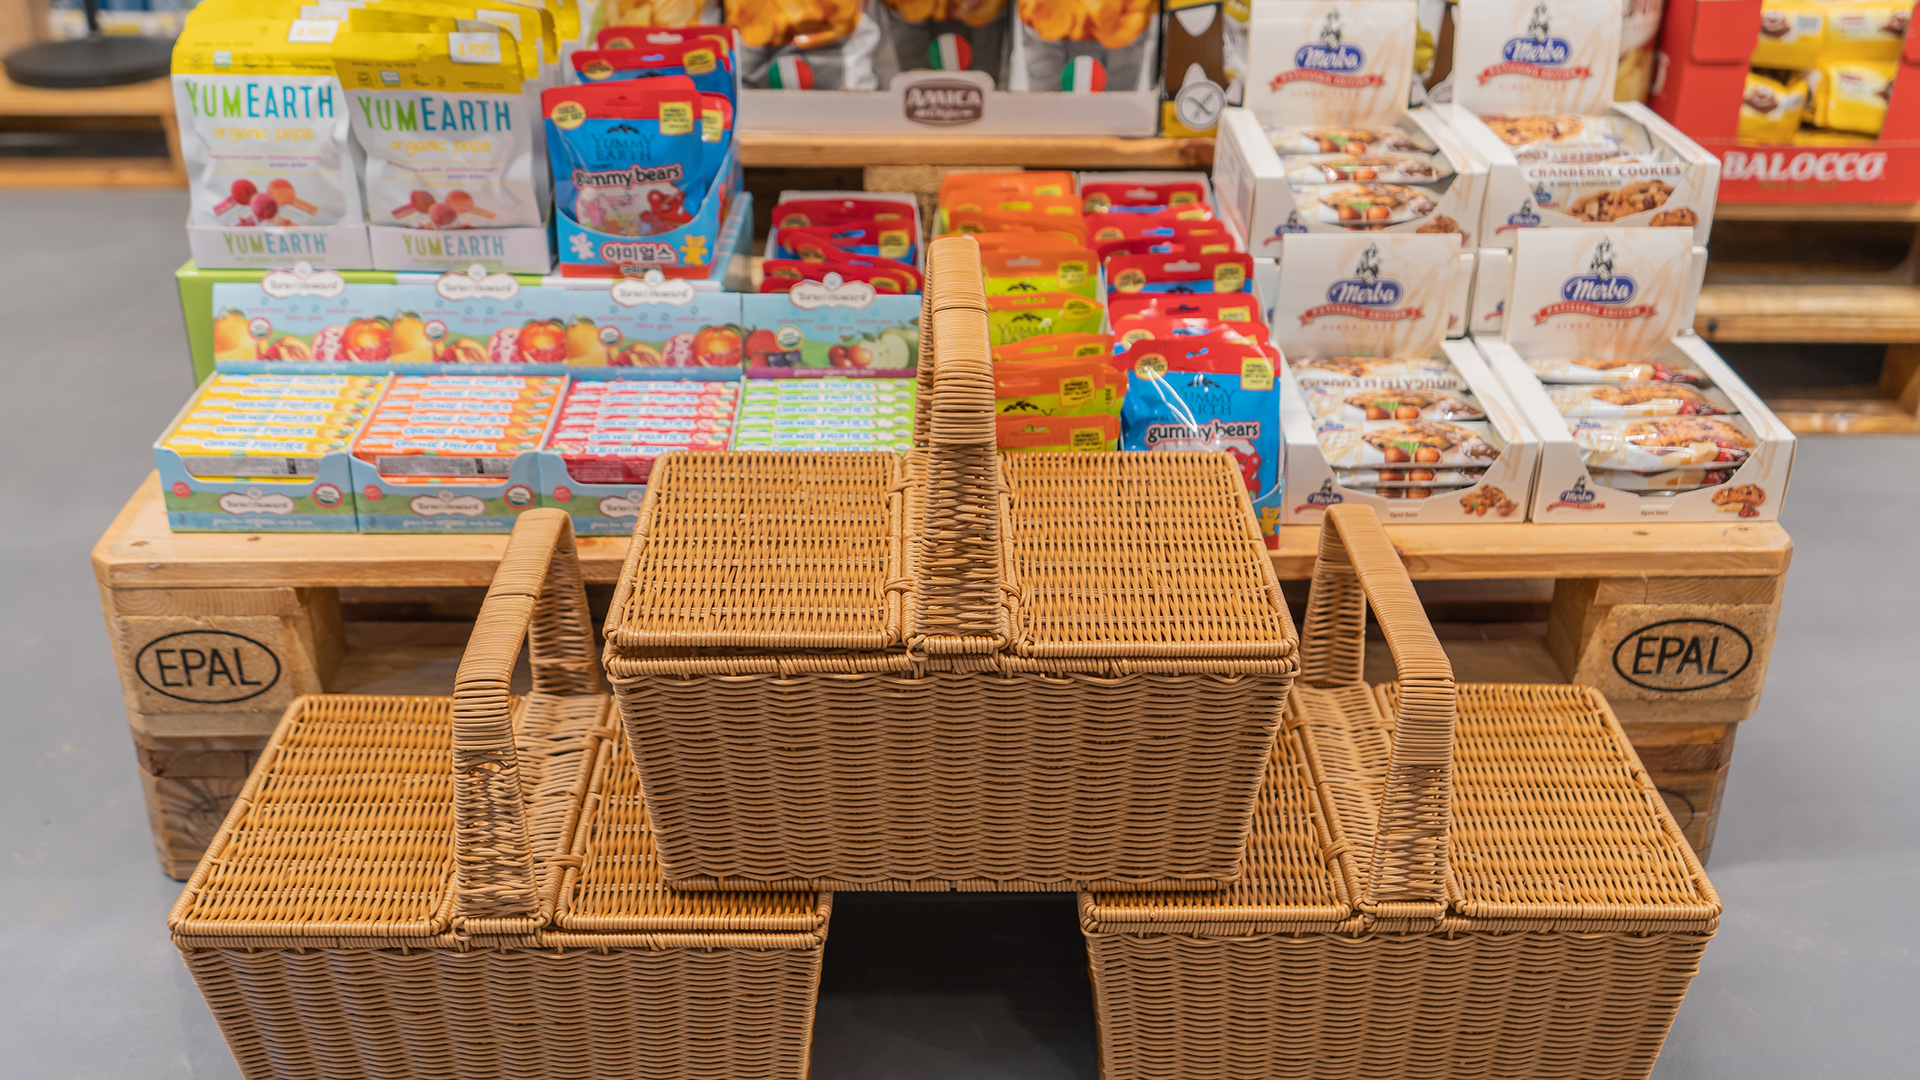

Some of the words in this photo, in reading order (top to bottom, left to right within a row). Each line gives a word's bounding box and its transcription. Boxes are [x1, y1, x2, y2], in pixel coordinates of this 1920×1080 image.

[1298, 45, 1359, 69] Merba
[1504, 38, 1566, 62] Merba
[185, 81, 334, 119] YUMEARTH
[906, 88, 981, 108] AMICA
[357, 96, 511, 132] YUMEARTH
[213, 126, 270, 143] organic
[275, 127, 314, 143] pops
[592, 133, 656, 150] YUMMY
[390, 139, 448, 157] organic
[453, 140, 492, 155] pops
[574, 171, 632, 189] gummy
[635, 165, 680, 183] bears
[1529, 166, 1613, 178] CRANBERRY
[1618, 166, 1681, 177] COOKIES
[1721, 150, 1888, 182] BALOCCO
[223, 231, 326, 254] YUMEARTH
[402, 233, 505, 257] YUMEARTH
[605, 245, 673, 261] 야미얼스
[1331, 280, 1396, 305] Merba
[1564, 276, 1629, 301] Merba
[1148, 426, 1211, 443] gummy
[1215, 422, 1259, 438] bears
[155, 647, 262, 687] EPAL
[1632, 636, 1729, 676] EPAL
